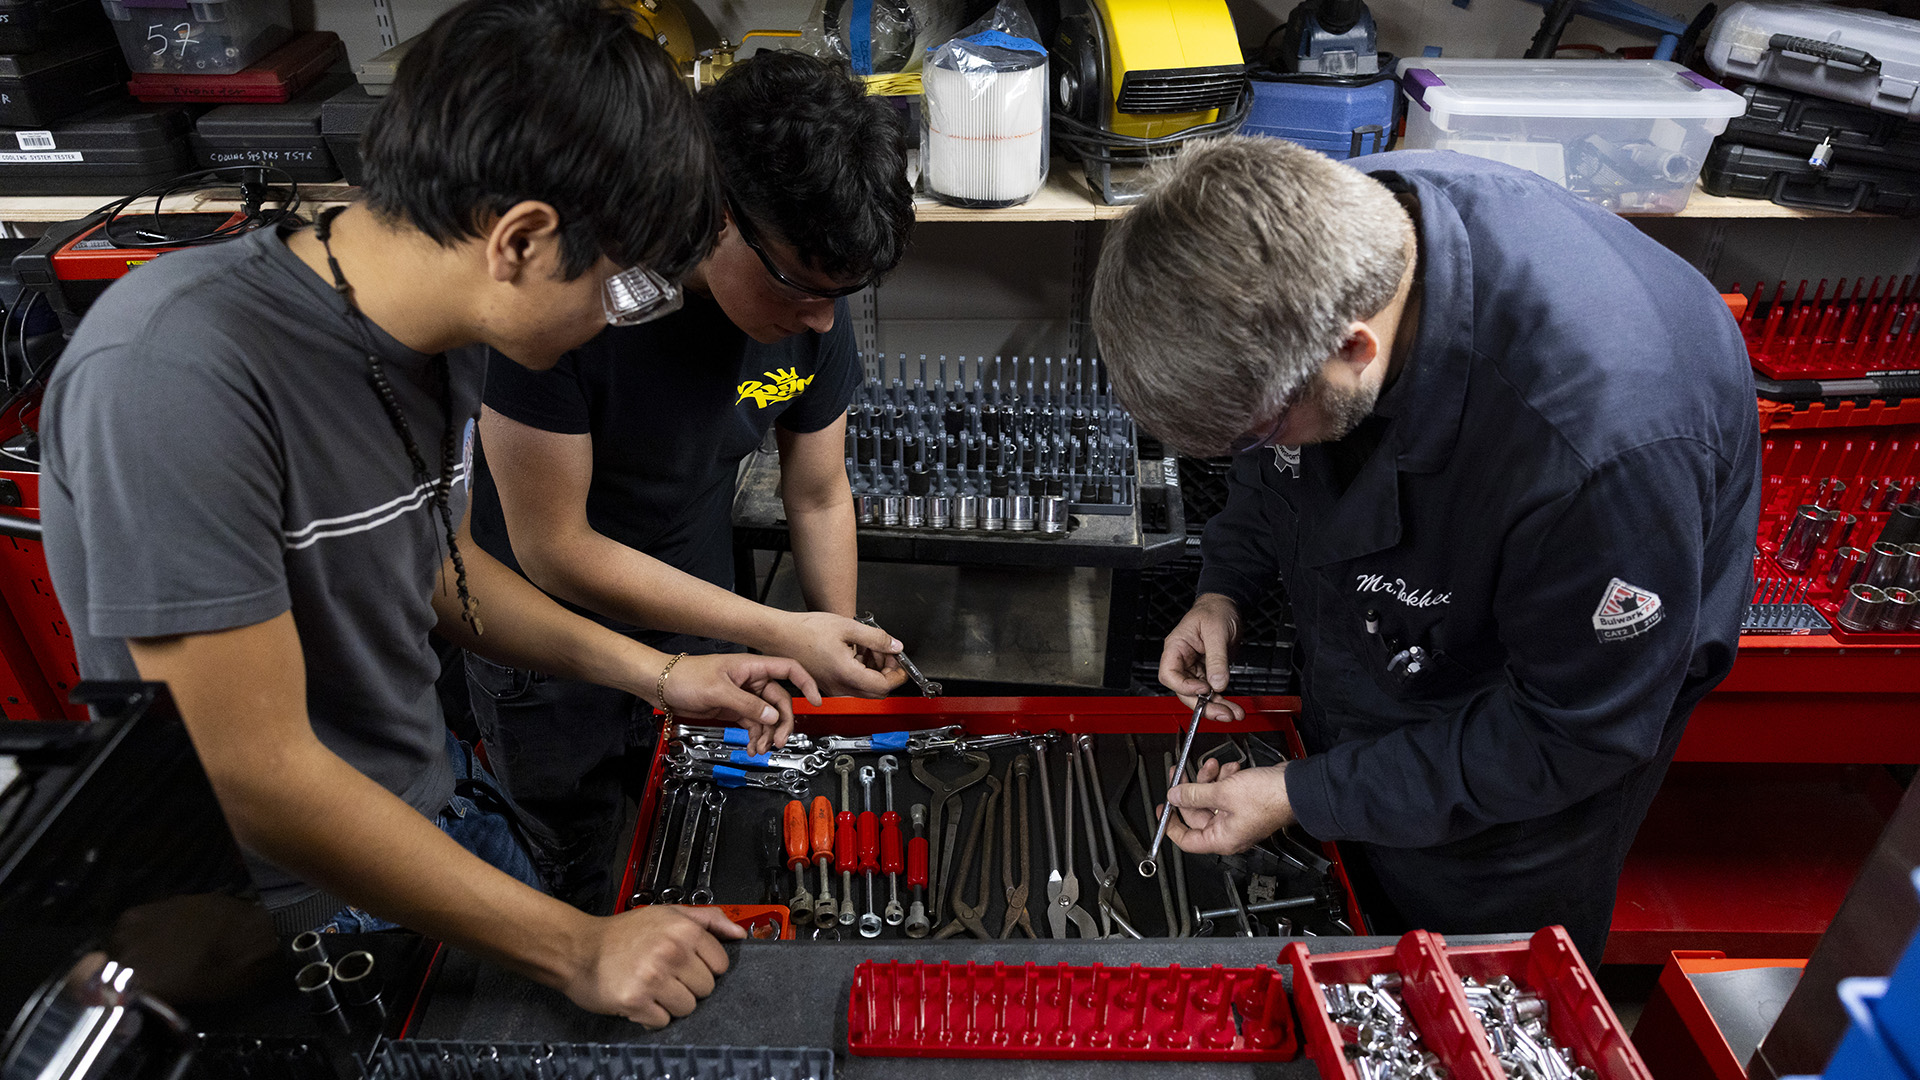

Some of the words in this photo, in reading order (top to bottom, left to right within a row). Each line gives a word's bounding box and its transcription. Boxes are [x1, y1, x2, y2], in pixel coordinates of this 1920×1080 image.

[146, 22, 200, 57] 57
[1355, 573, 1397, 595] Mr.
[1599, 610, 1643, 626] Bulwark
[1644, 600, 1656, 613] FR
